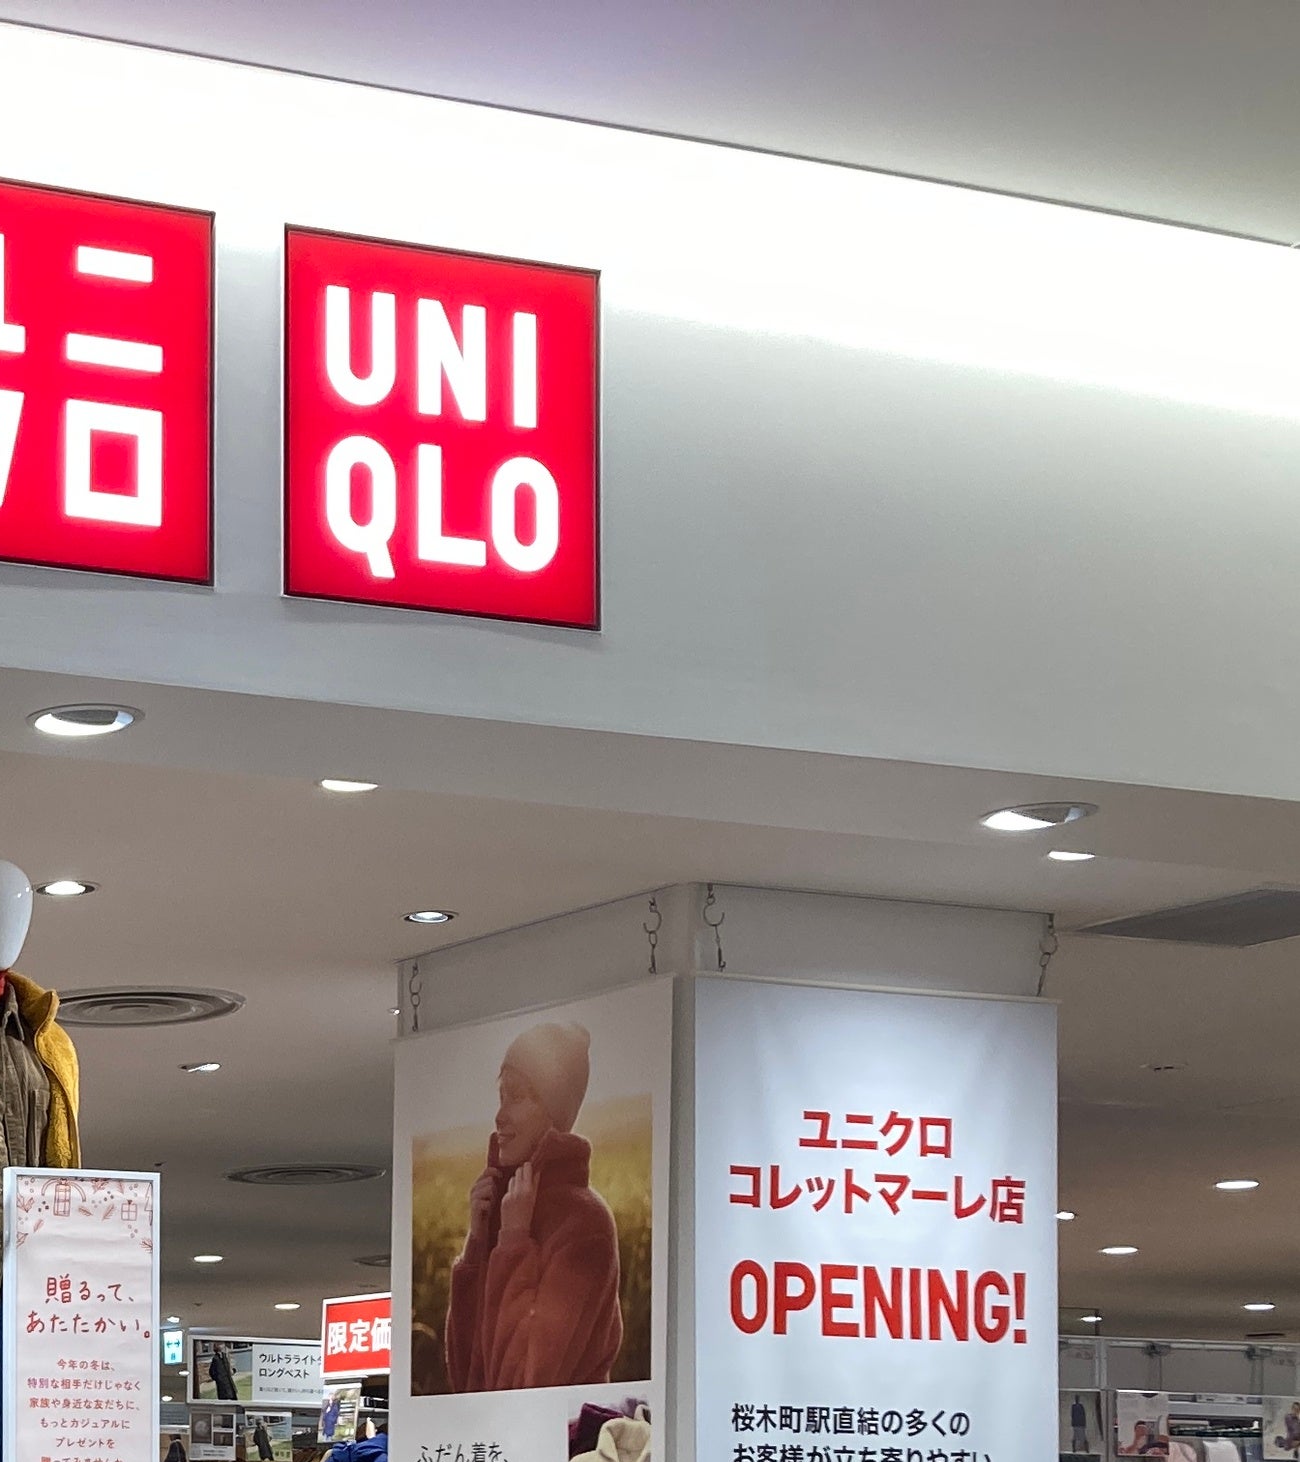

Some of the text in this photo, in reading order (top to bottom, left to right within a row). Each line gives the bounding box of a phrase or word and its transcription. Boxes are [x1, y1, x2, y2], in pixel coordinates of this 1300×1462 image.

[324, 283, 540, 430] UNI
[324, 434, 560, 580] QLO
[799, 1111, 952, 1158] ユニクロ
[729, 1165, 1025, 1224] コレットマーレ店
[44, 1273, 135, 1304] 贈るって、
[730, 1259, 1027, 1344] OPENING!
[26, 1309, 151, 1339] あたたかい。
[56, 1358, 116, 1372] 今年の冬は、
[258, 1367, 311, 1379] ロングベスト
[40, 1417, 131, 1430] もっとカジュアルに
[731, 1403, 971, 1437] 桜木町駅直結の多くの
[55, 1437, 116, 1449] プレゼントを
